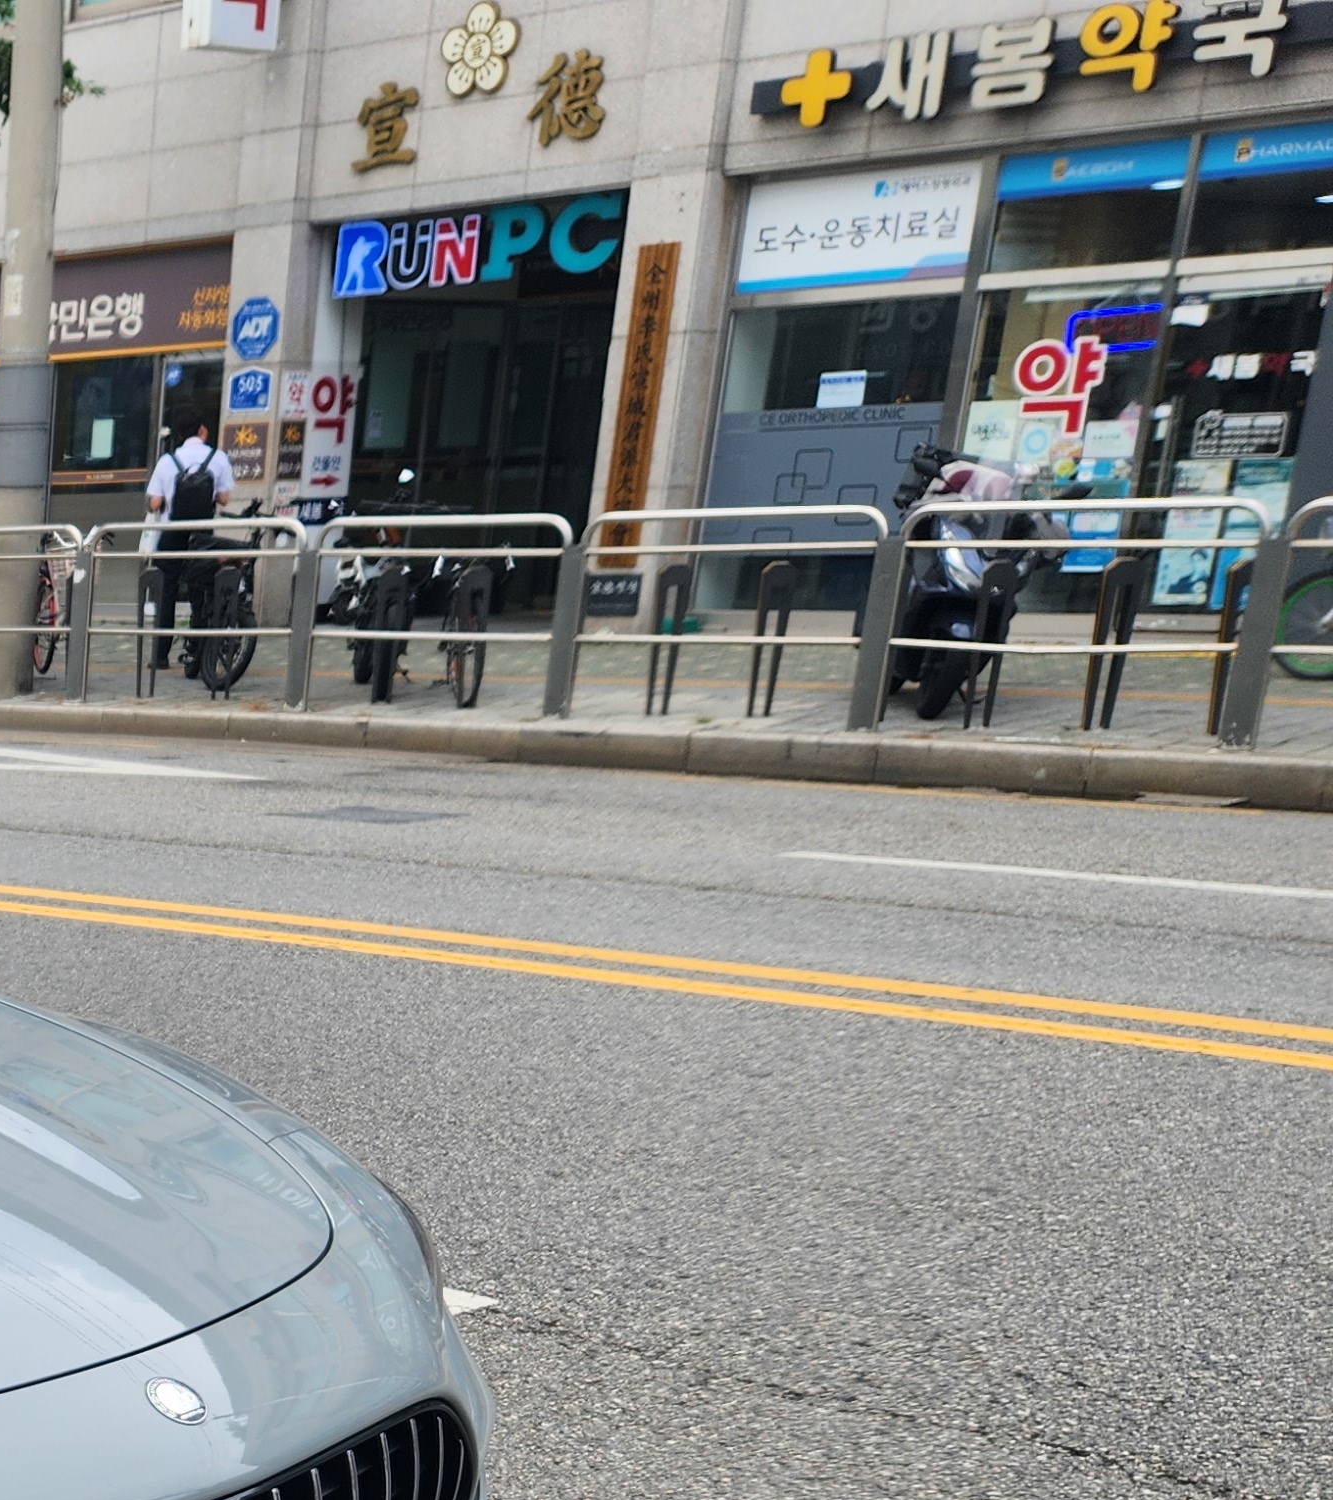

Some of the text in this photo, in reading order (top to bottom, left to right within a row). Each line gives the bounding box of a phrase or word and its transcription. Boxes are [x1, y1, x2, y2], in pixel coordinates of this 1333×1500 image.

[865, 0, 1288, 120] 새봄약국
[480, 196, 623, 281] PC
[237, 315, 273, 343] ADT
[312, 374, 354, 444] 약
[1015, 336, 1108, 438] 약
